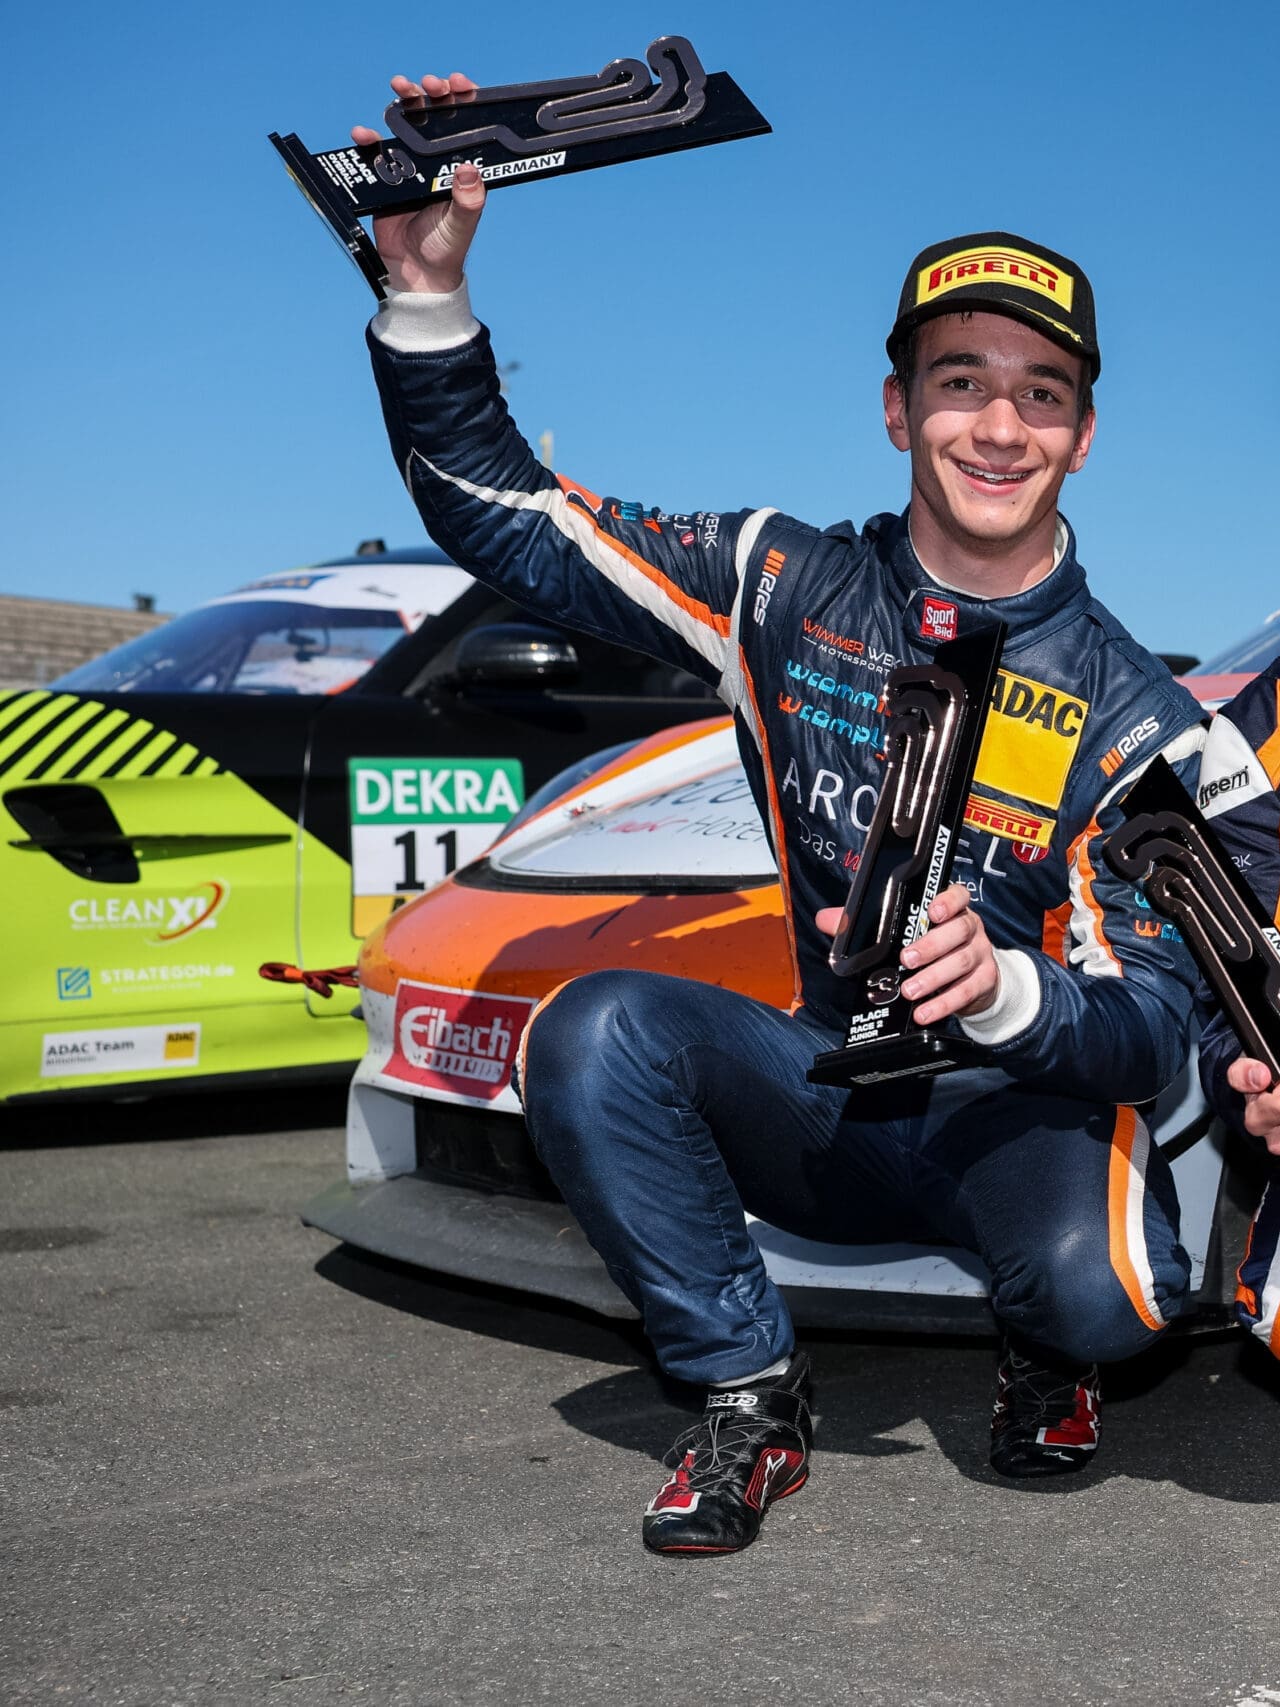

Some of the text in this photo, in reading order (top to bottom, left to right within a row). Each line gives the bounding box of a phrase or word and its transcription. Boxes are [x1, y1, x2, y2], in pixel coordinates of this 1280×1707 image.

[481, 154, 562, 179] GERMANY
[927, 251, 1059, 293] PIRELLI
[925, 605, 956, 627] Sport
[802, 616, 865, 656] WIMMER
[934, 624, 953, 640] Bild
[818, 644, 891, 677] MOTORSPORT
[1117, 715, 1160, 759] RRS
[355, 768, 522, 816] DEKRA
[1199, 766, 1251, 807] freem
[850, 1020, 884, 1035] RACE 2
[851, 1007, 890, 1025] PLACE
[47, 1039, 135, 1057] ADAC Team
[400, 1005, 512, 1062] Eibach
[847, 1029, 878, 1043] JUNIOR
